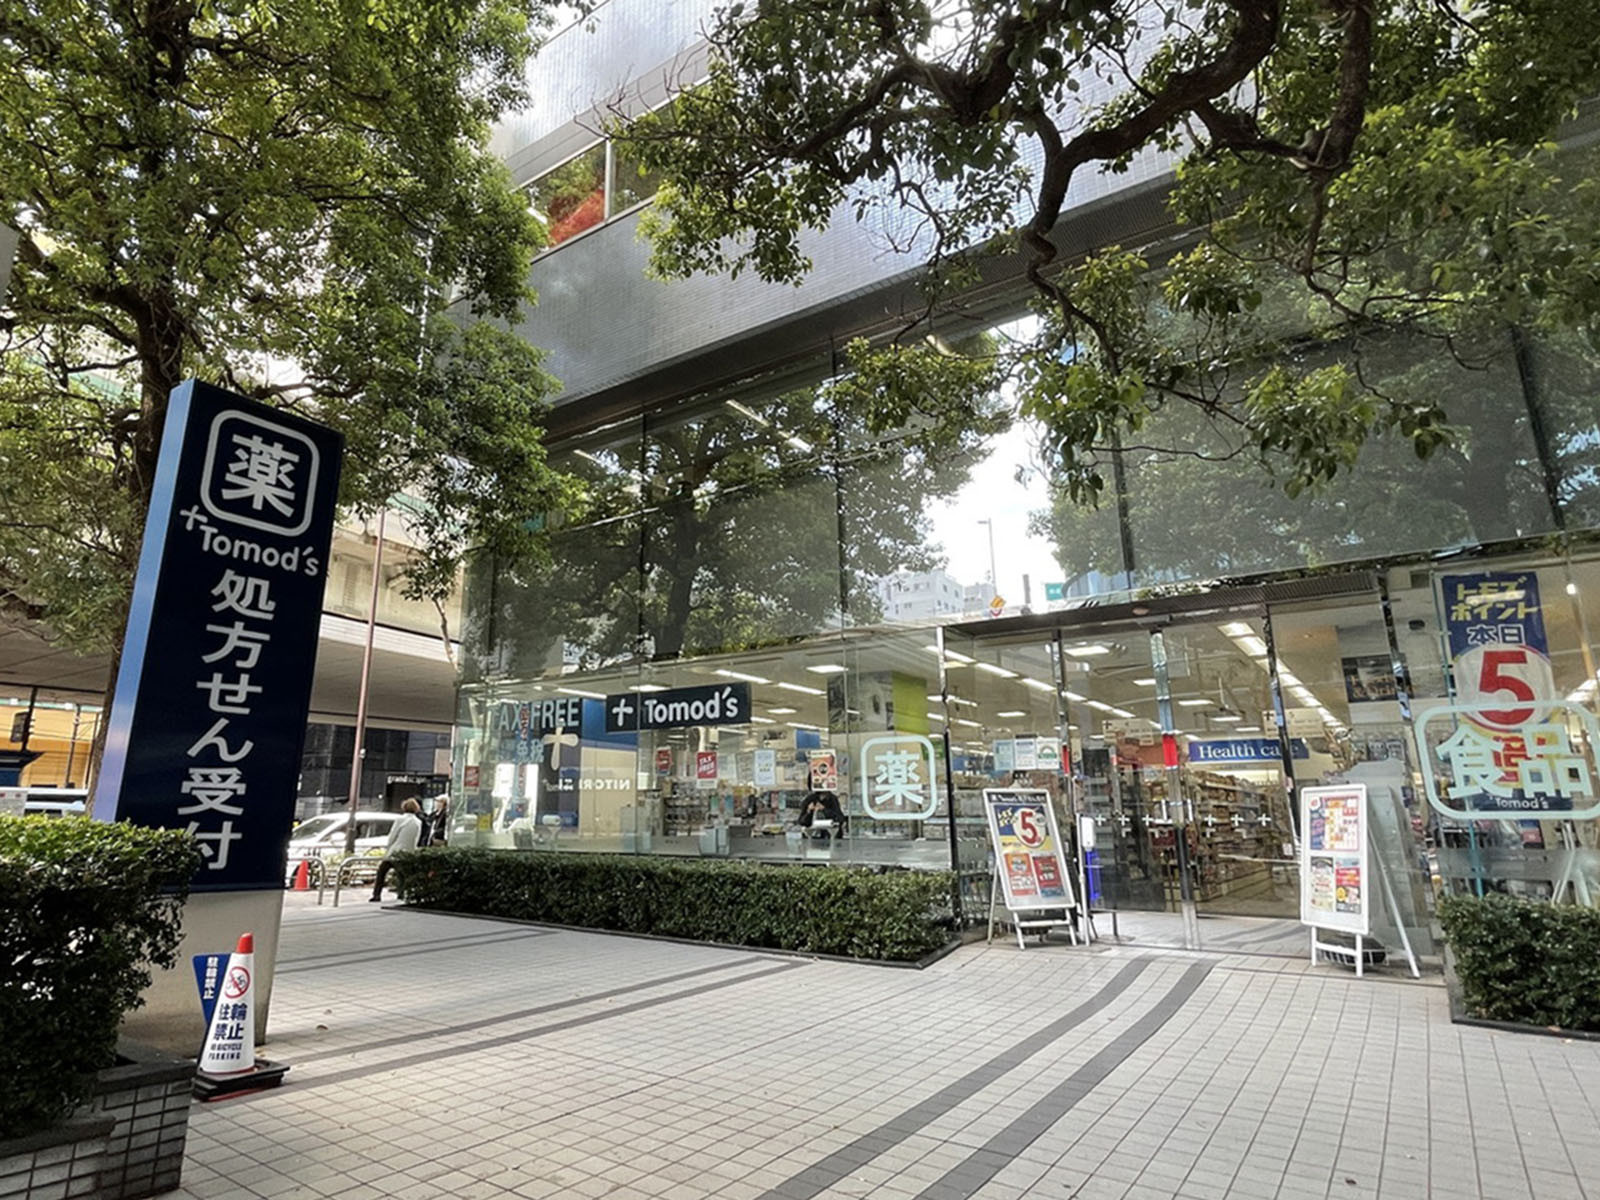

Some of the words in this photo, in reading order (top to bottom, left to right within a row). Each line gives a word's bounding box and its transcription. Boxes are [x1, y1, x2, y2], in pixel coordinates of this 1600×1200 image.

[221, 434, 300, 518] 薬
[199, 525, 319, 576] Tomod's
[1466, 624, 1526, 646] 本日
[644, 686, 738, 723] Tomod's
[1478, 650, 1536, 725] 5
[177, 568, 276, 870] 処方せん受付
[530, 697, 579, 730] FREE
[1199, 744, 1255, 759] Health
[1260, 745, 1298, 757] cae
[1436, 723, 1593, 800] 食品
[875, 751, 923, 805] 薬
[1495, 797, 1549, 809] Tomod's
[1020, 811, 1038, 844] 5
